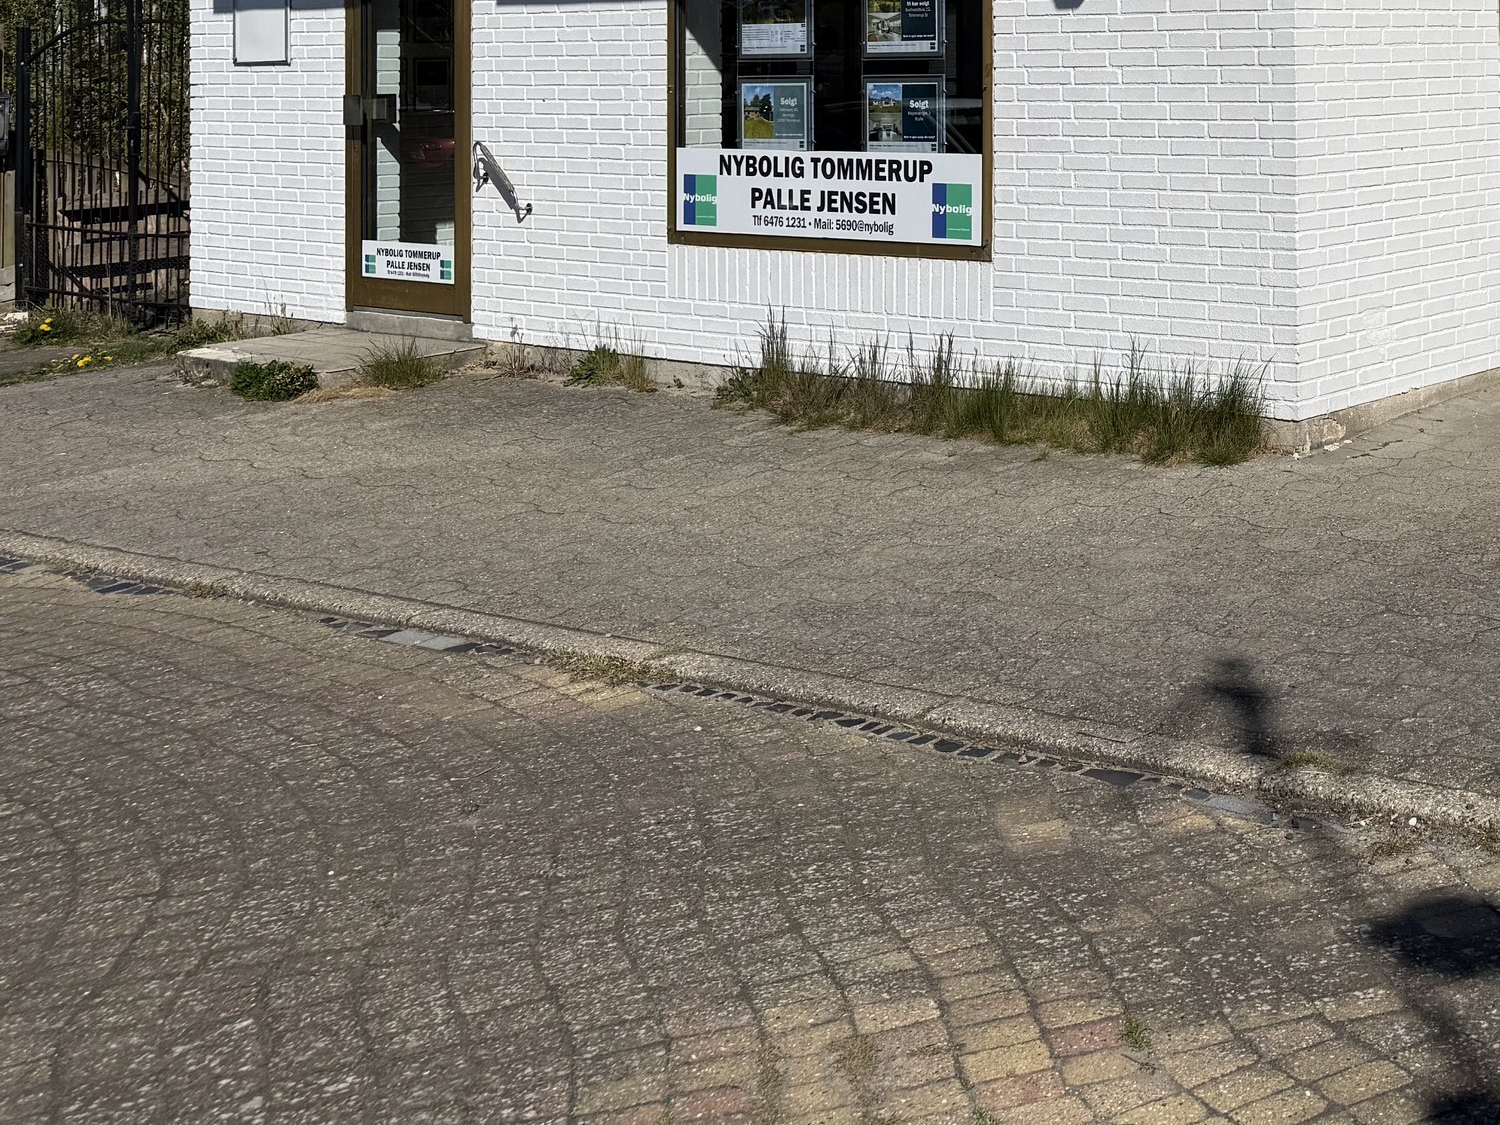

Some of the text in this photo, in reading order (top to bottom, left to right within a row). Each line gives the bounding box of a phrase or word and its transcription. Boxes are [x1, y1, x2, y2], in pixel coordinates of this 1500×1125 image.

[719, 154, 933, 182] NYBOLIG TOMMERUP
[683, 192, 717, 204] Nybolig
[751, 187, 896, 215] PALLE JENSEN
[932, 203, 972, 216] Nybolig
[763, 215, 784, 227] 6476
[785, 217, 807, 229] 1231
[813, 218, 834, 230] Mail:
[835, 219, 894, 235] 5690@nybolig
[376, 247, 441, 260] NYBOLIG TOMMERUP
[386, 260, 405, 269] PALLE
[407, 261, 431, 272] JENSEN
